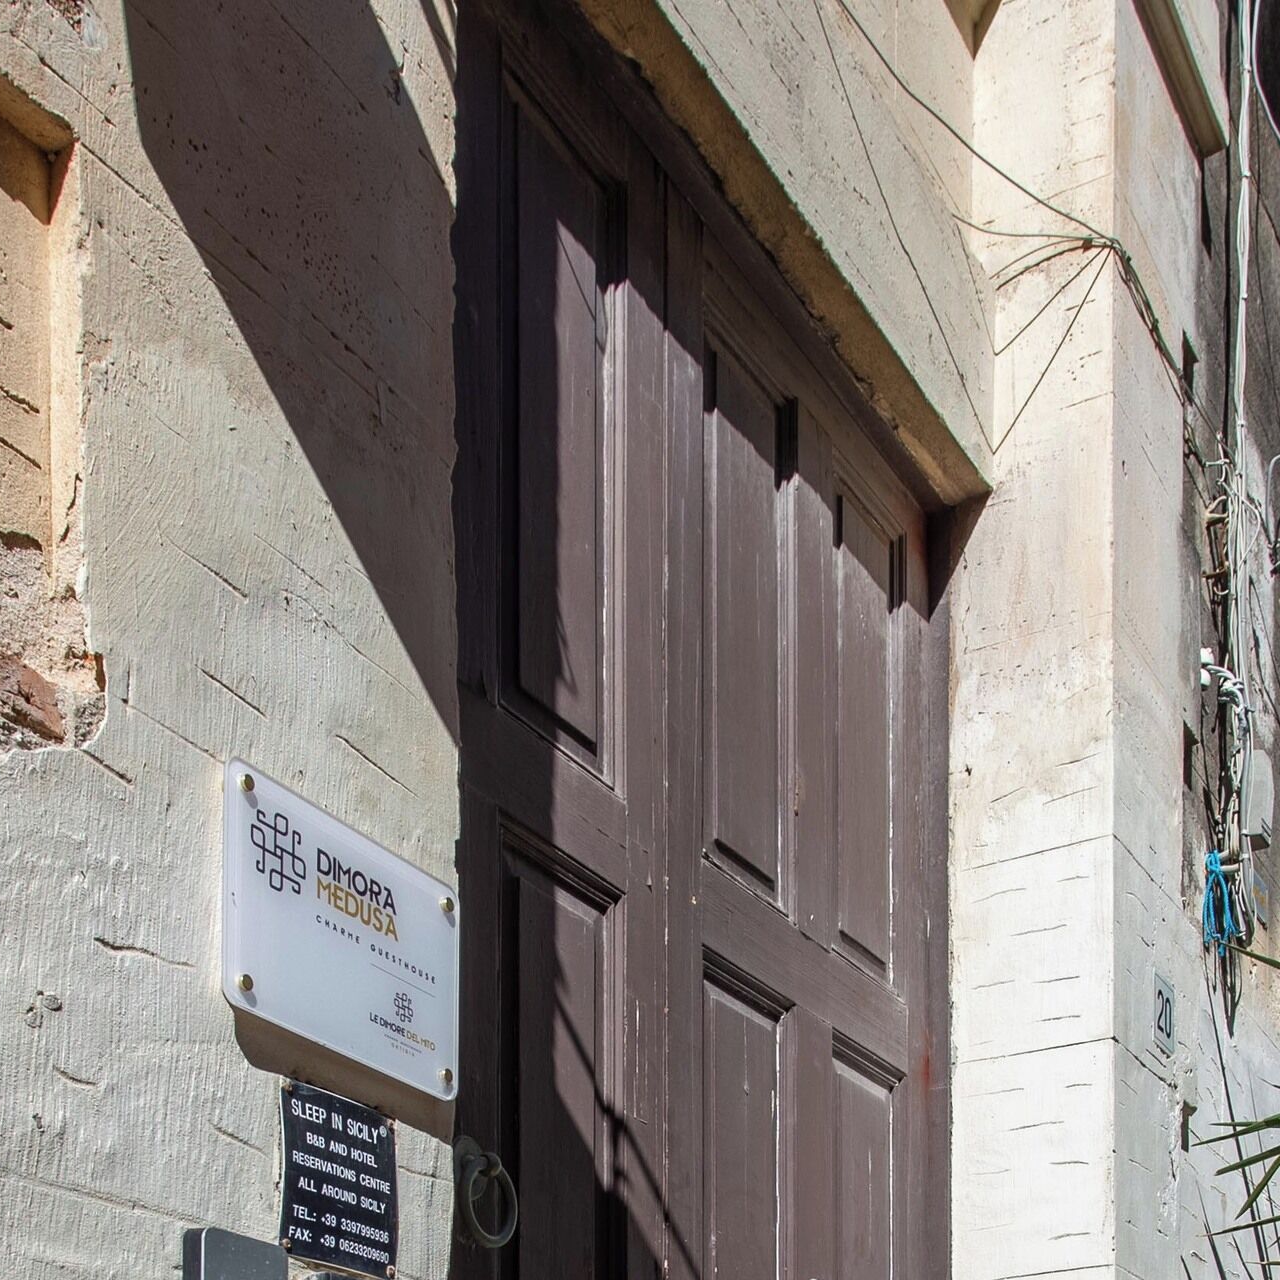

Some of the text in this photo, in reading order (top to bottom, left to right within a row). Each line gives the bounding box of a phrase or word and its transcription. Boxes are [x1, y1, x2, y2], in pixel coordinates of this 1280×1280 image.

[316, 847, 398, 917] DIMORA
[316, 875, 400, 942] MEDUSA
[315, 914, 437, 985] CHARME GUESTHOUSE
[369, 1011, 380, 1025] LE
[379, 1016, 407, 1038] DIMORE
[406, 1030, 420, 1045] DEL
[1156, 989, 1172, 1039] 20
[290, 1098, 328, 1125] SLEEP
[331, 1111, 344, 1132] IN
[306, 1131, 379, 1169] B&B AND HOTEL
[292, 1150, 392, 1195] RESERVATIONS CENTRE
[298, 1176, 387, 1215] ALL AROUND SICILY
[288, 1225, 391, 1265] FAX: +39 06233209690
[292, 1204, 391, 1245] TEL.: +39 3397995936
